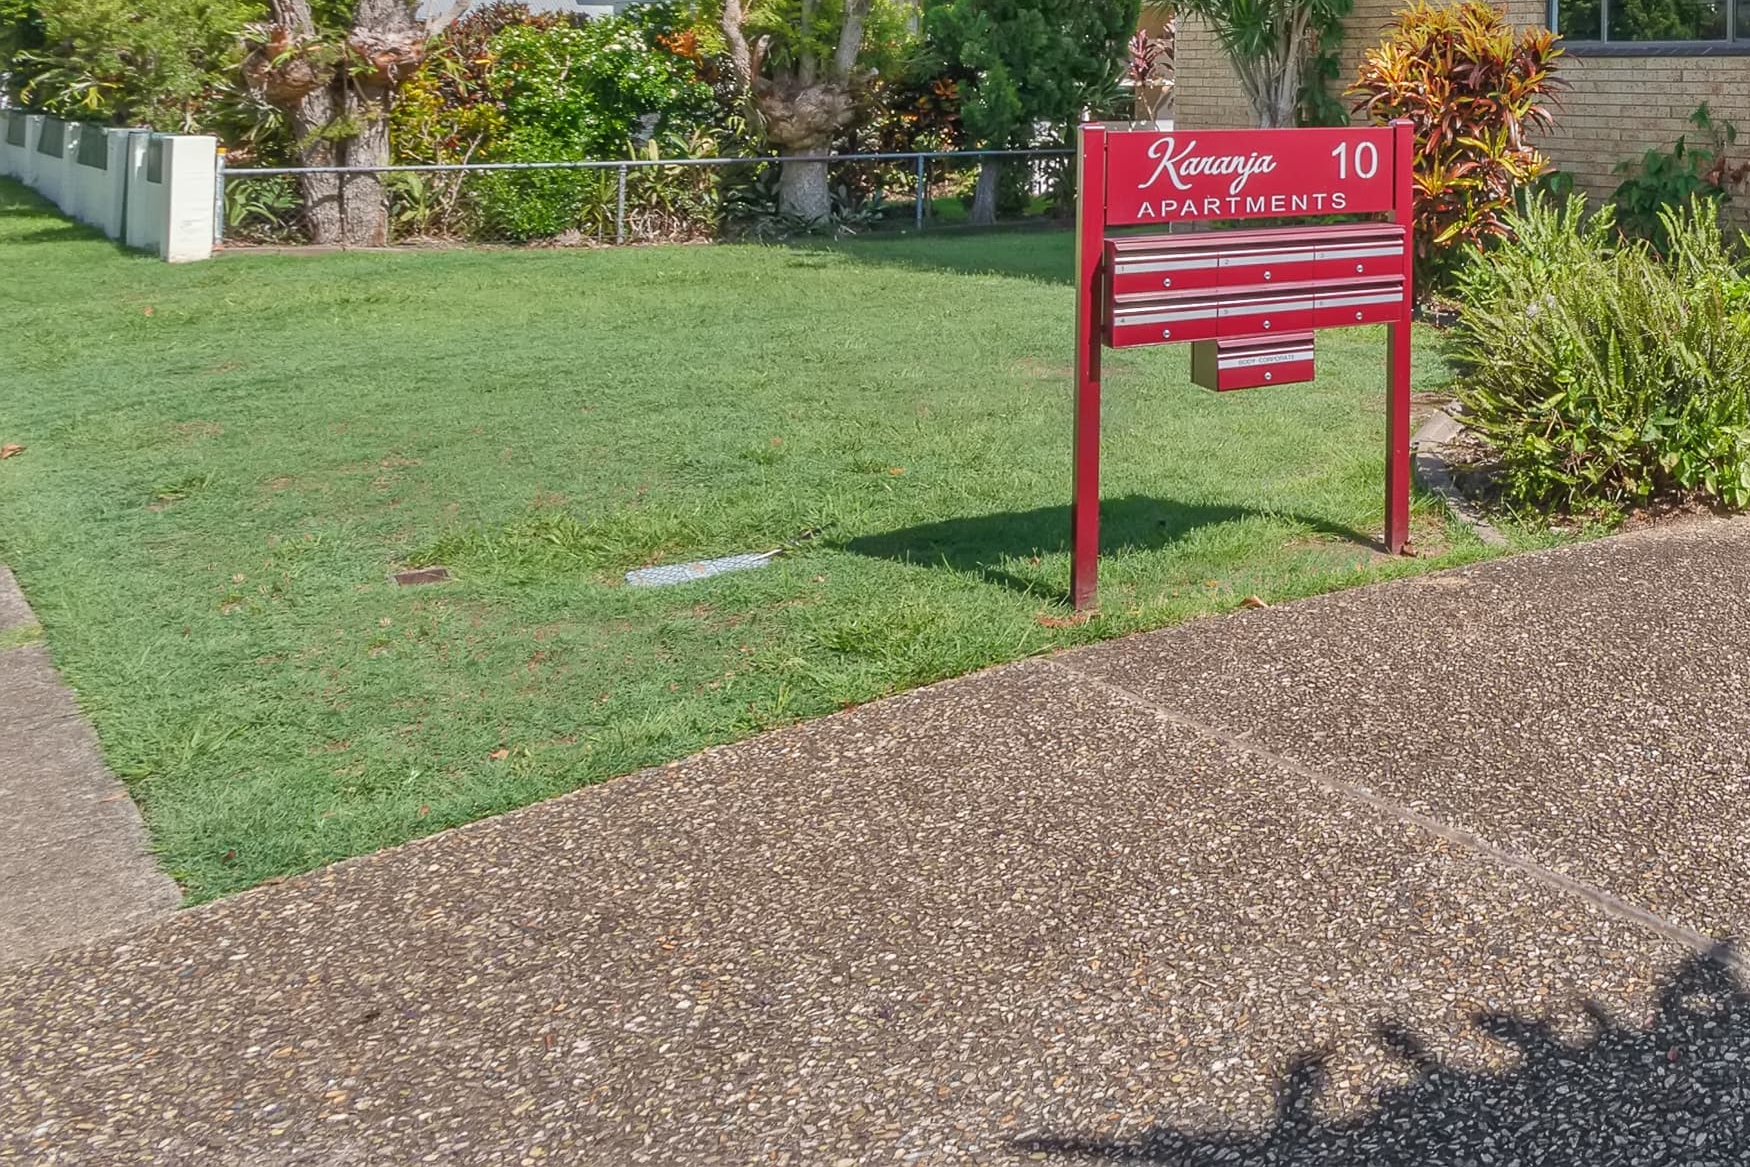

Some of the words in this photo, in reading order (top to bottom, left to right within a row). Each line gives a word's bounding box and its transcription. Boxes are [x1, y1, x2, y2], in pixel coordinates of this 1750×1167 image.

[1138, 136, 1277, 195] Karanja
[1331, 141, 1379, 179] 10
[1137, 192, 1347, 218] APARTMENTS
